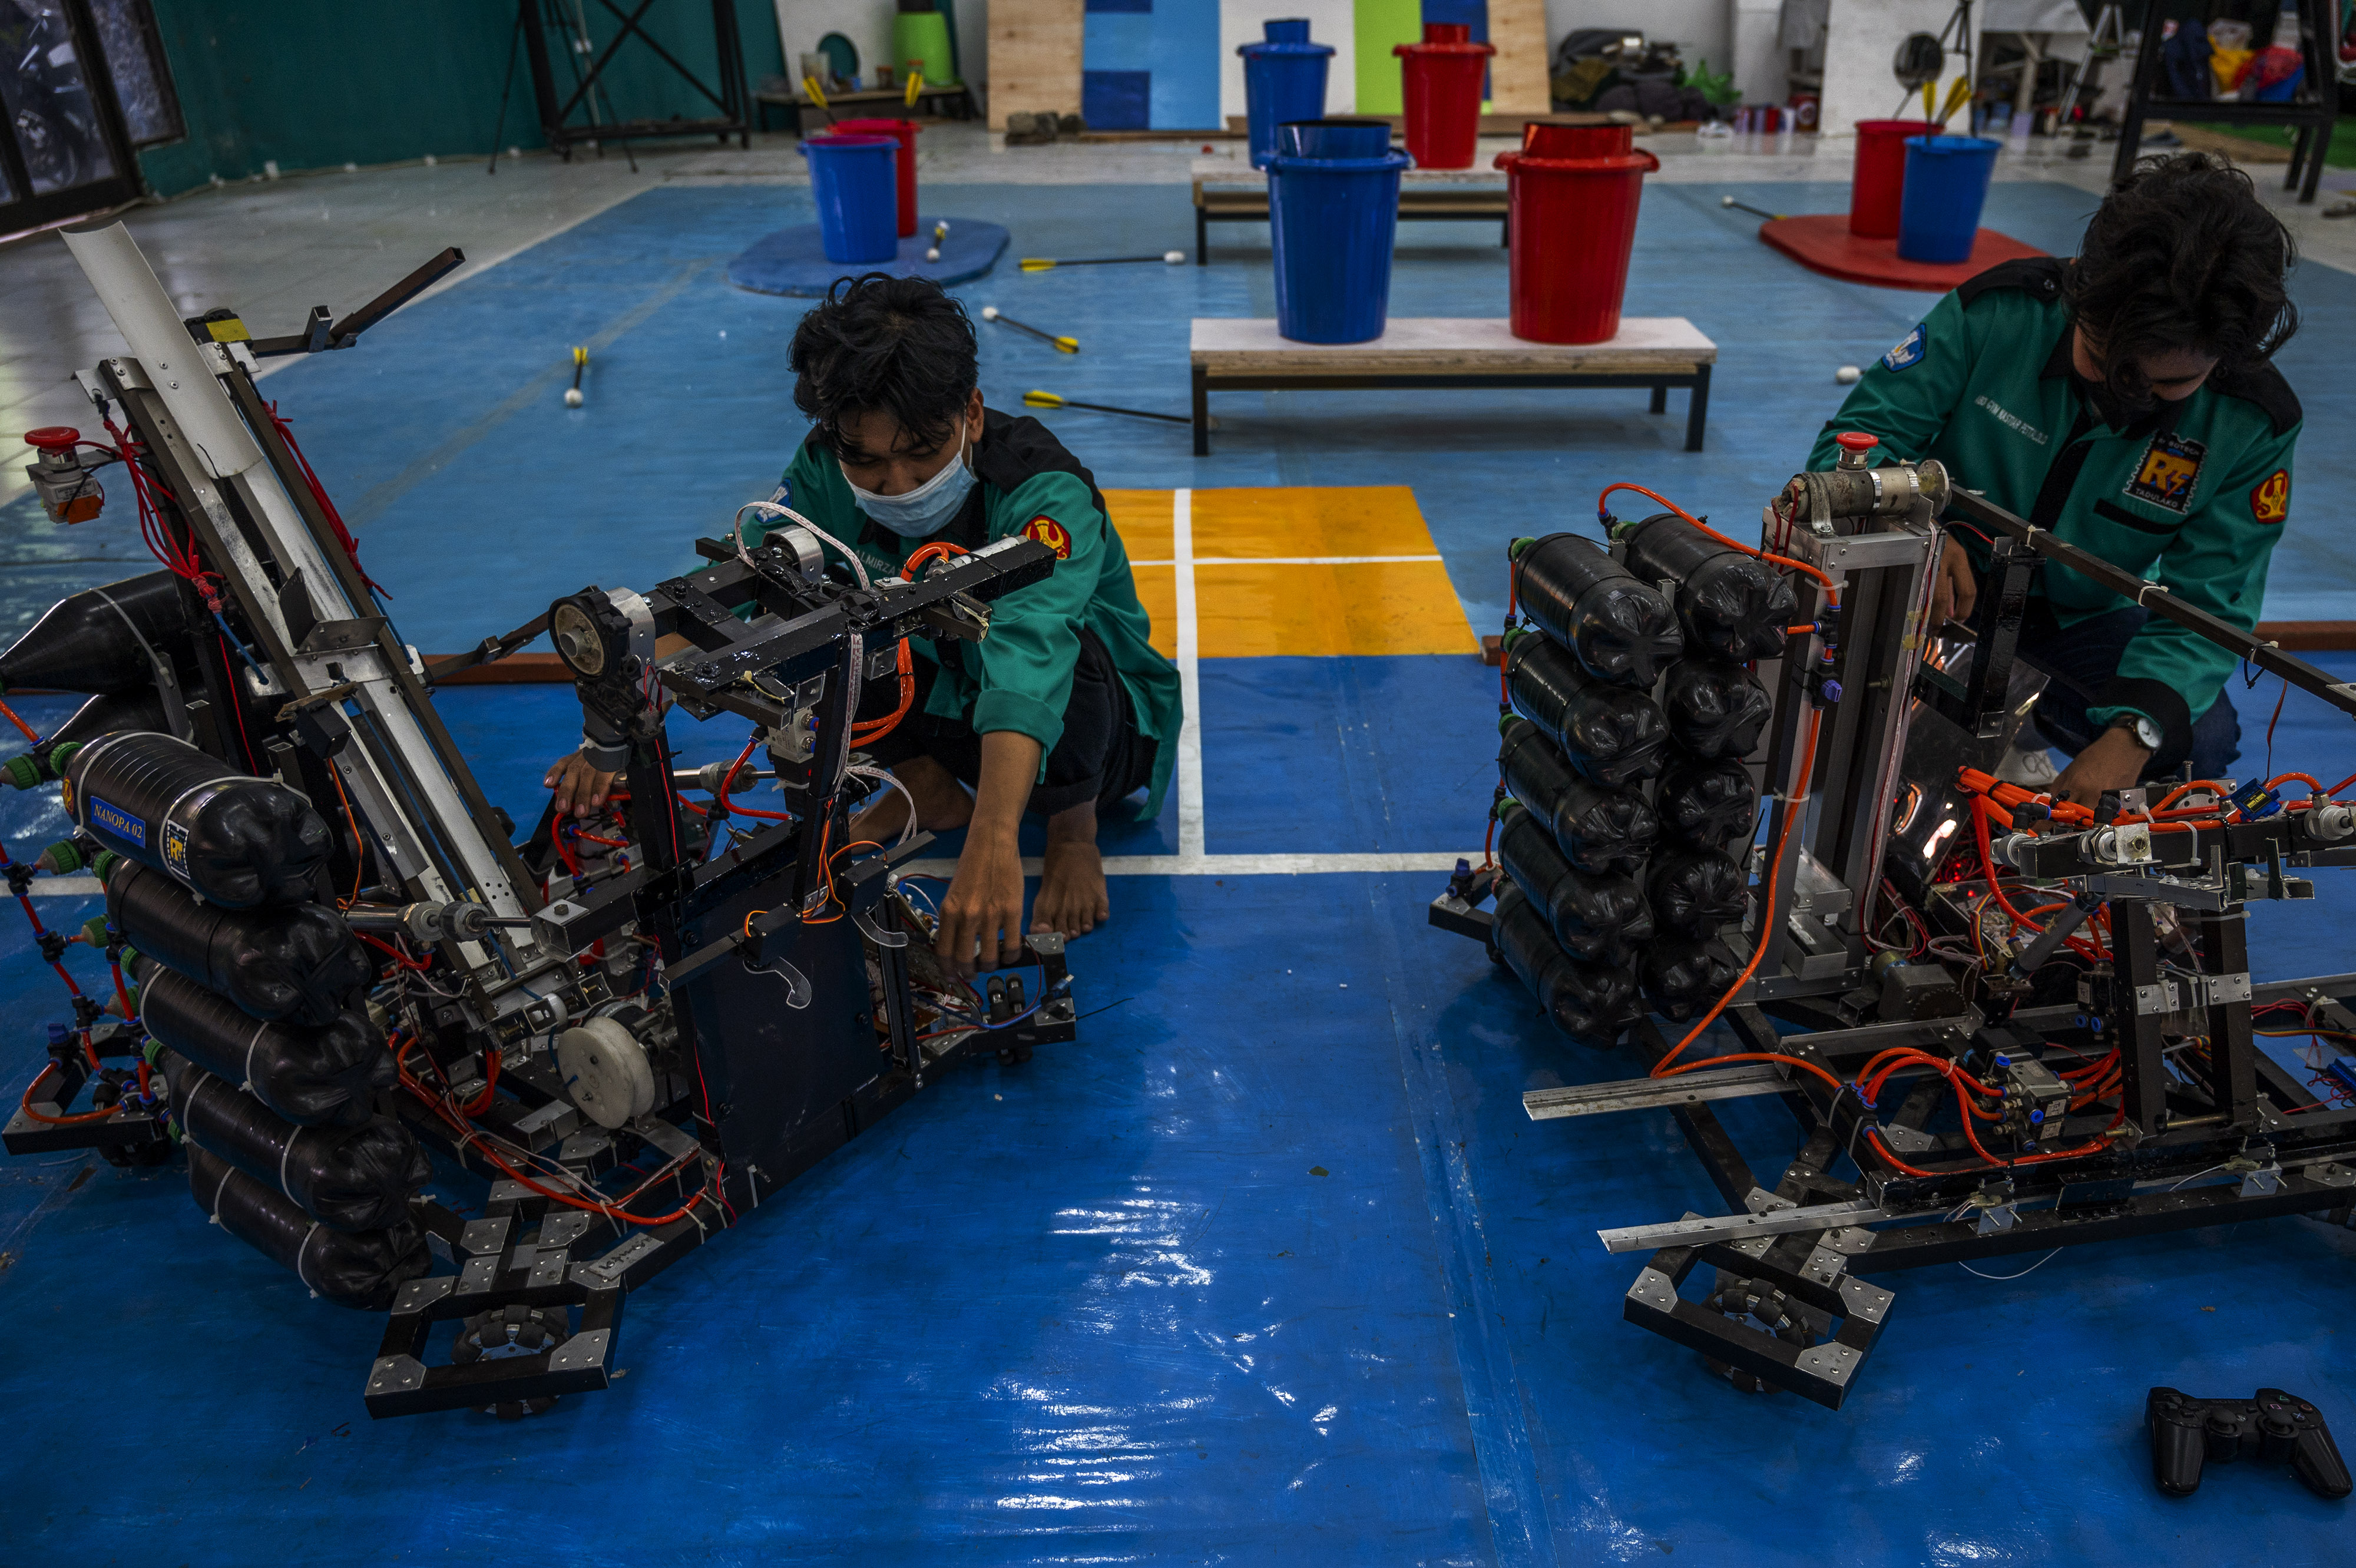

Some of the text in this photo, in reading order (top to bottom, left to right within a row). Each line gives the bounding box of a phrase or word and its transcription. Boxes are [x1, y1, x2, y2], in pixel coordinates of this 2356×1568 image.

[2135, 488, 2179, 508] TADULAKO
[94, 803, 143, 839] NANOPA 02
